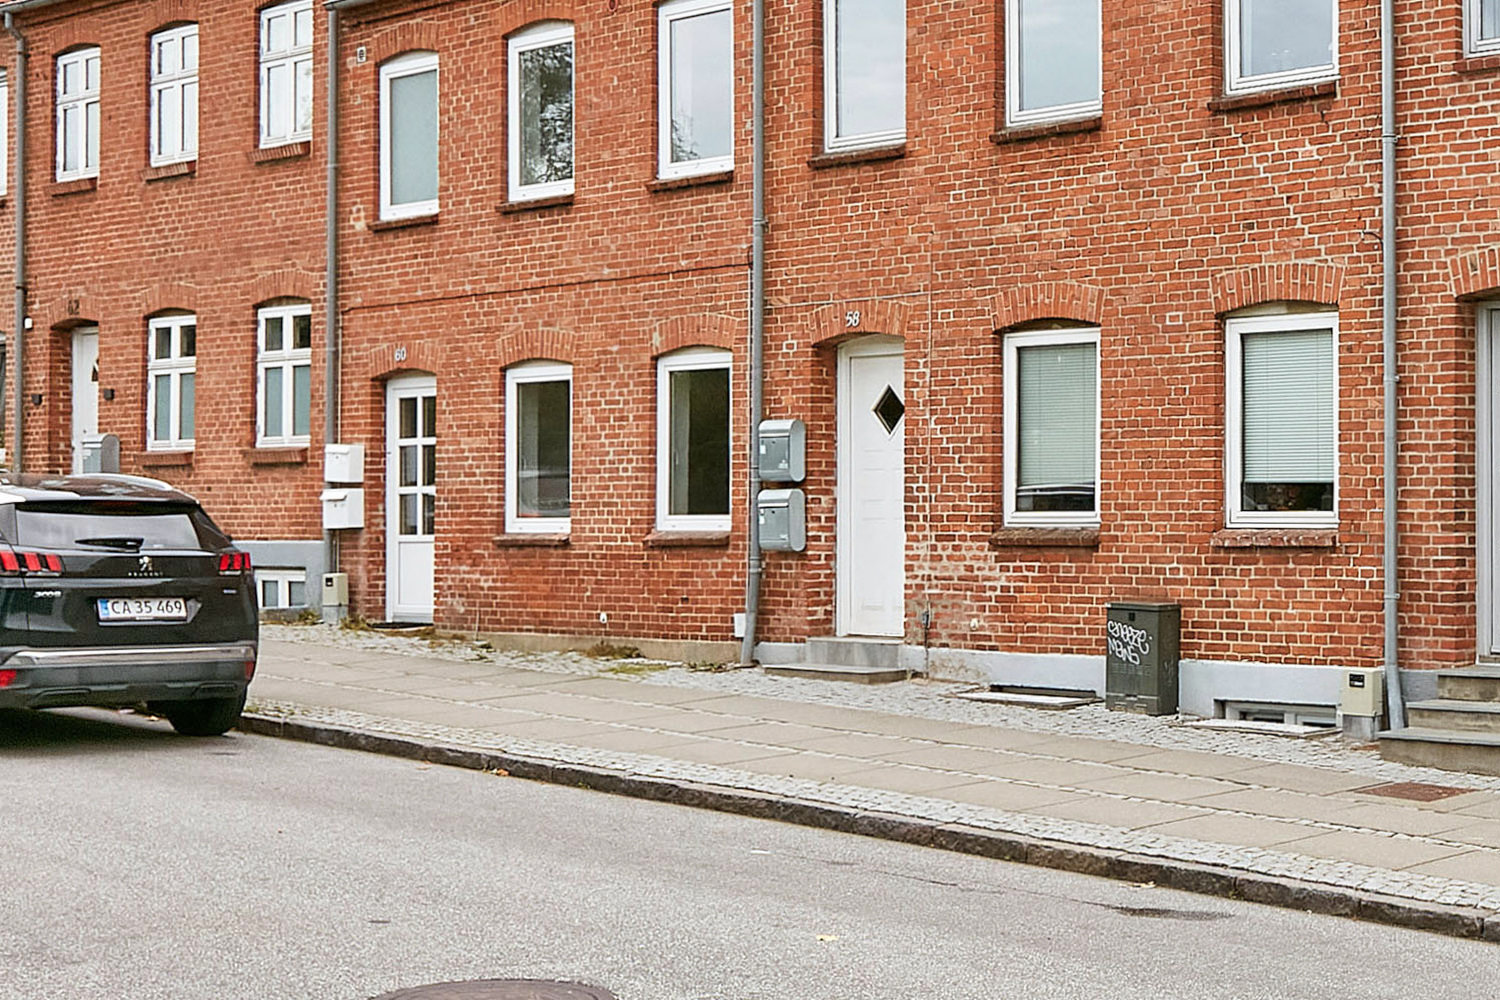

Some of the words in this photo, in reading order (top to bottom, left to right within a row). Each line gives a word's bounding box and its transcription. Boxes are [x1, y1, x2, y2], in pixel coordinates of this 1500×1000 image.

[845, 311, 860, 327] 58
[395, 347, 406, 360] 60
[111, 601, 132, 614] CA
[135, 601, 153, 614] 35
[156, 600, 182, 613] 469
